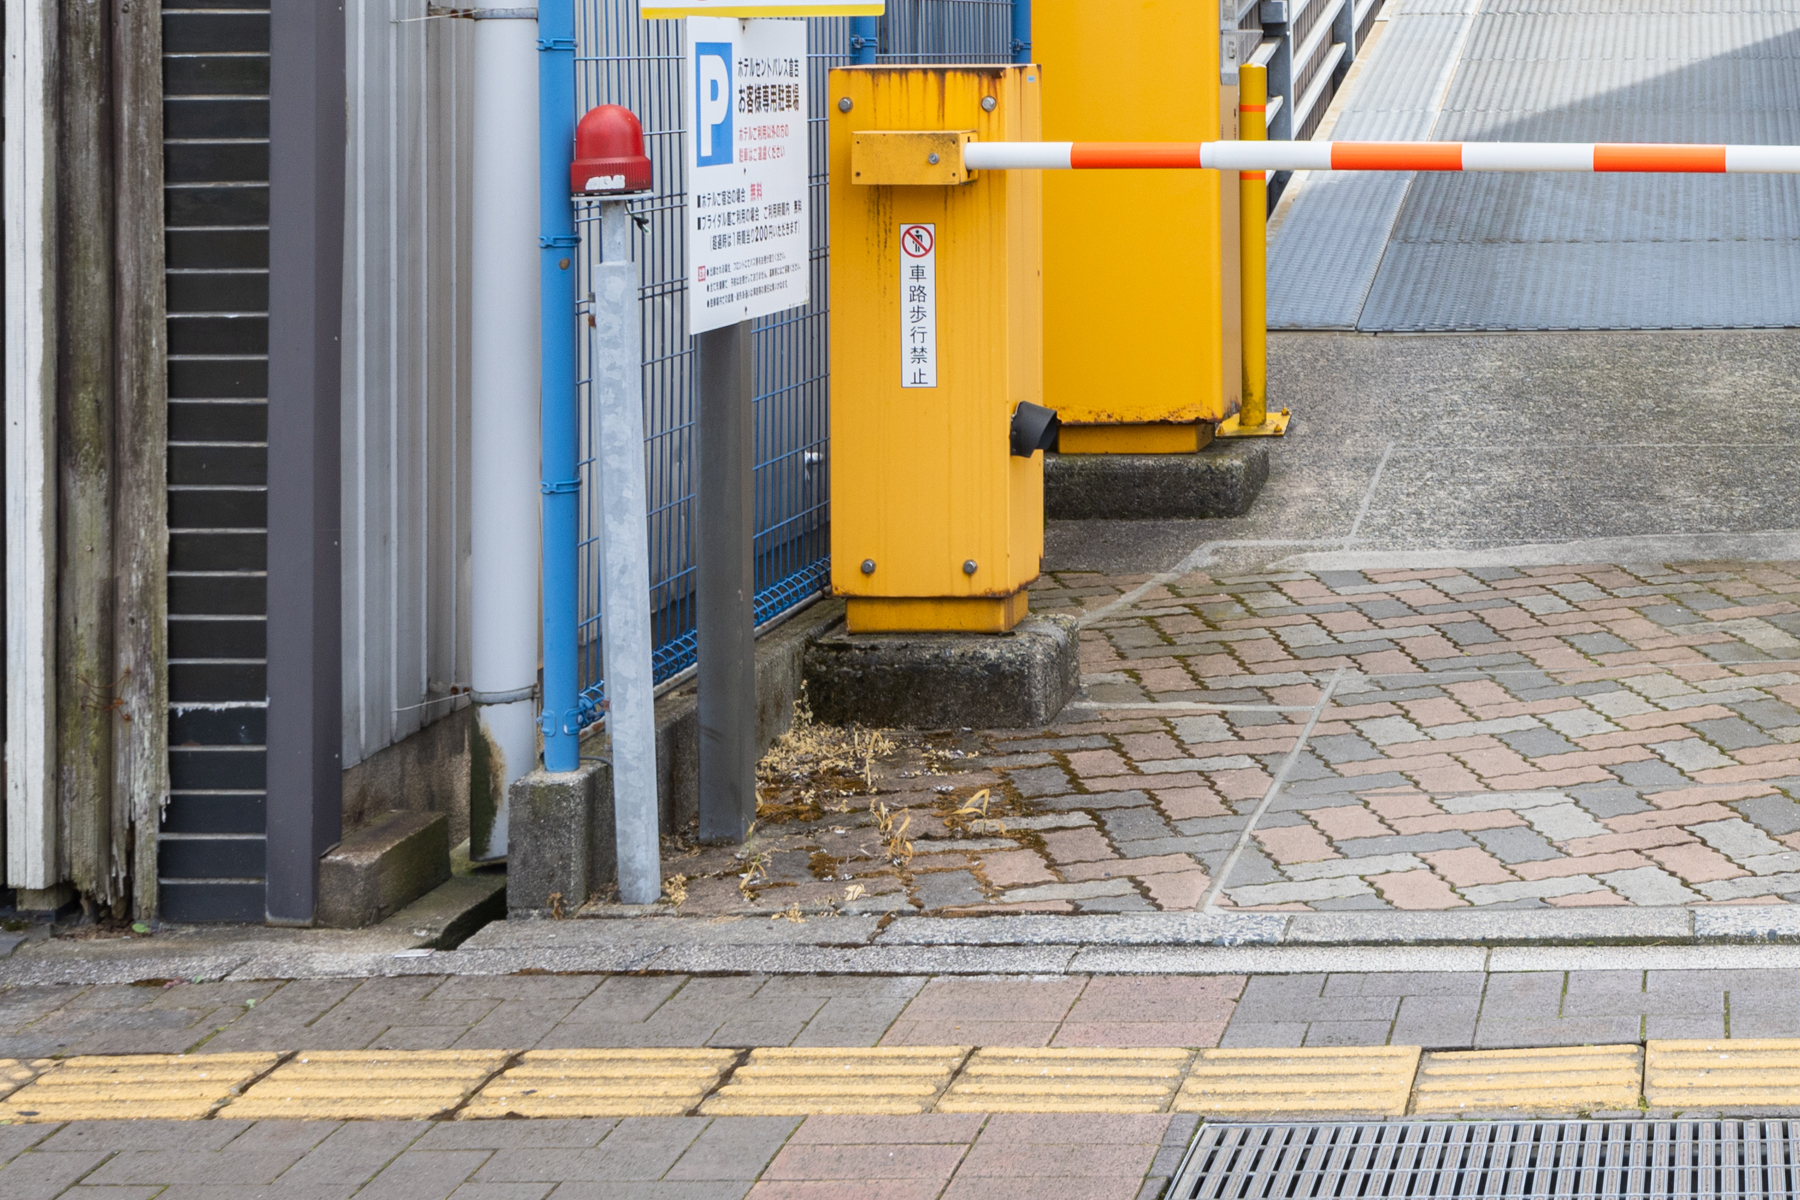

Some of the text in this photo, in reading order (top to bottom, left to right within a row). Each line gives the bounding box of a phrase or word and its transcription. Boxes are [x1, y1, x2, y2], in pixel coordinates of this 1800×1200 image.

[700, 54, 729, 157] P
[738, 83, 799, 114] お客様専用駐車場
[909, 264, 928, 385] 車路歩行禁止
